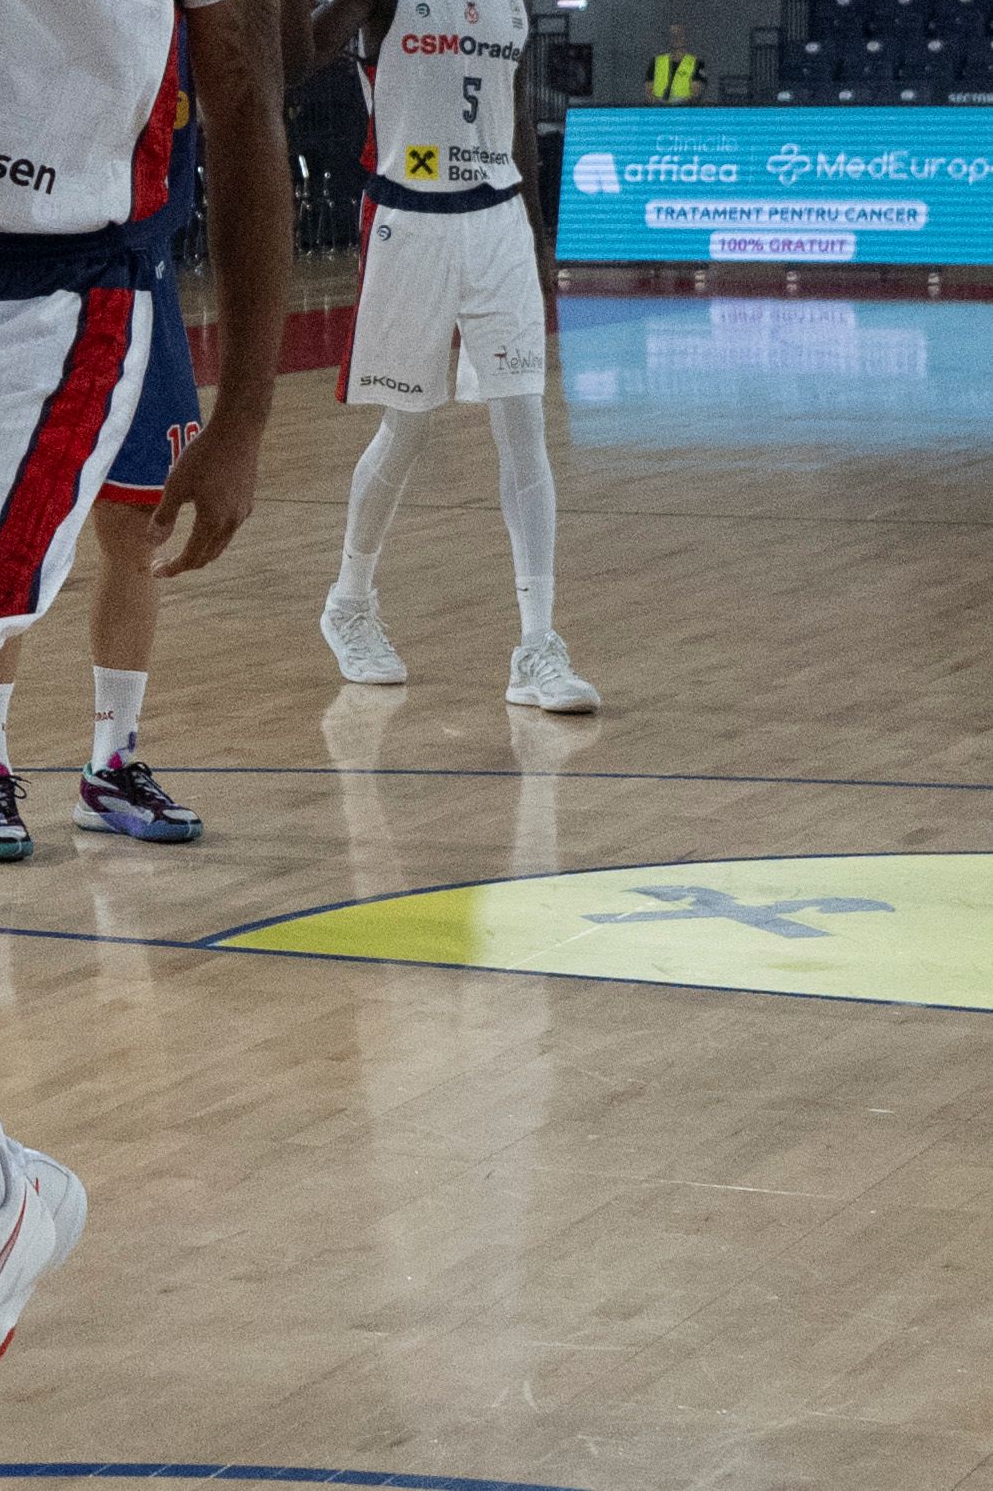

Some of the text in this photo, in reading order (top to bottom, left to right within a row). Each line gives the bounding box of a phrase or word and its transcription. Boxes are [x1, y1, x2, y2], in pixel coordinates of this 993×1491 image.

[401, 33, 522, 62] CSMOrade
[462, 76, 483, 124] 5
[623, 150, 993, 186] affidea MedEurop
[654, 206, 919, 223] TRATAMENT PENTRU CANCER
[719, 238, 848, 255] 100% GRATUIT
